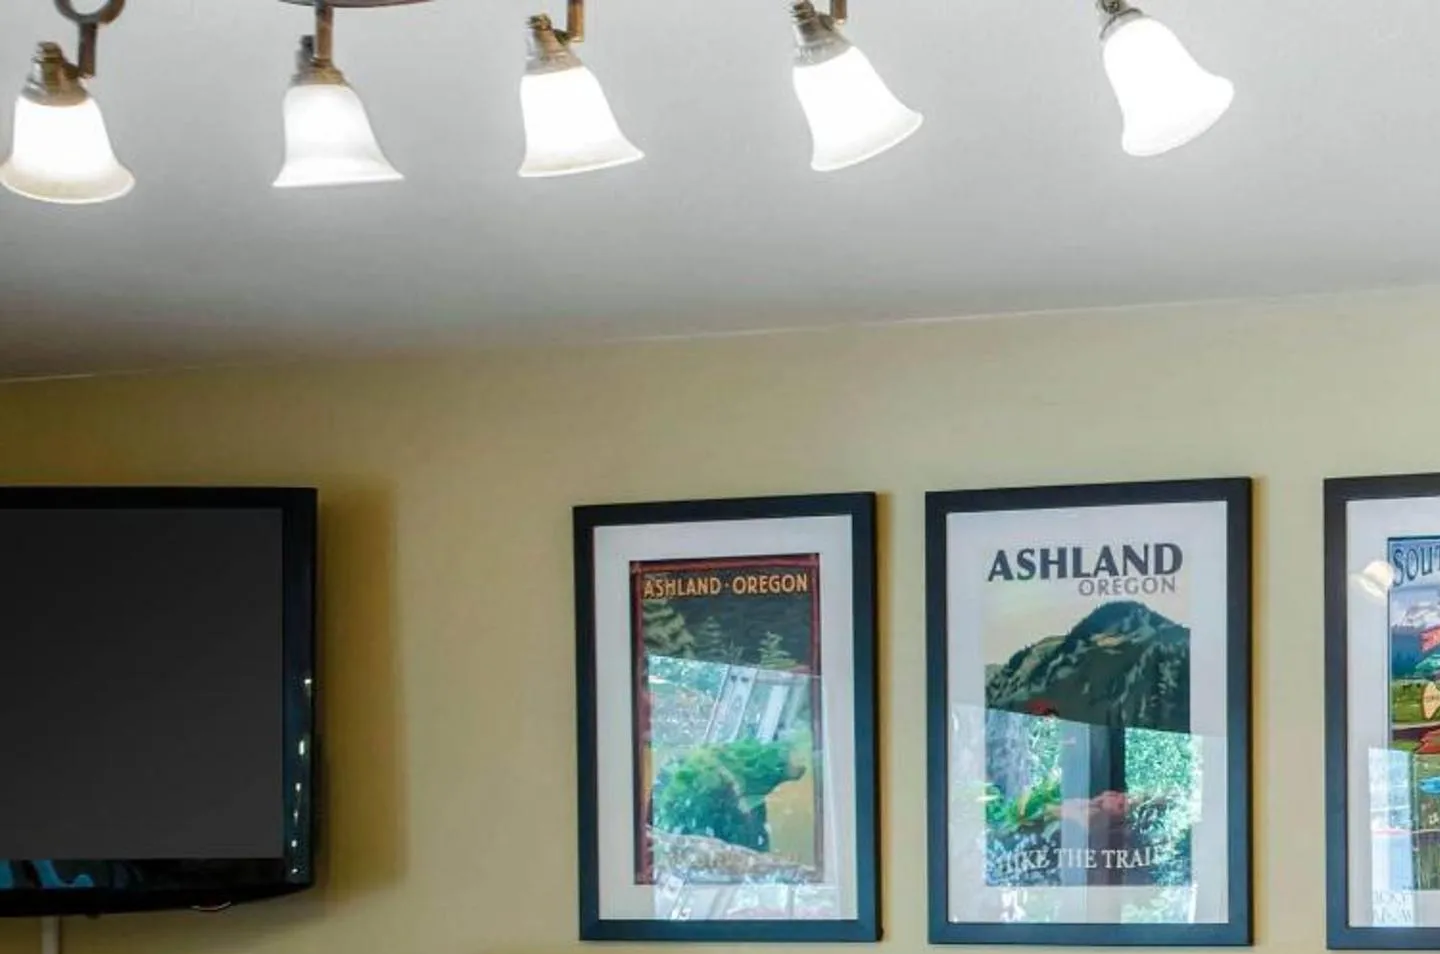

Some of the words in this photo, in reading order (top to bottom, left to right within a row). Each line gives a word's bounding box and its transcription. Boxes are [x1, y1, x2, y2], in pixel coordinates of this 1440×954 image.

[987, 542, 1183, 582] ASHLAND
[643, 577, 721, 598] ASHLAND
[732, 573, 808, 595] OREGON
[1078, 576, 1176, 597] OREGON
[1053, 848, 1098, 869] THE
[1101, 845, 1165, 869] TRAI
